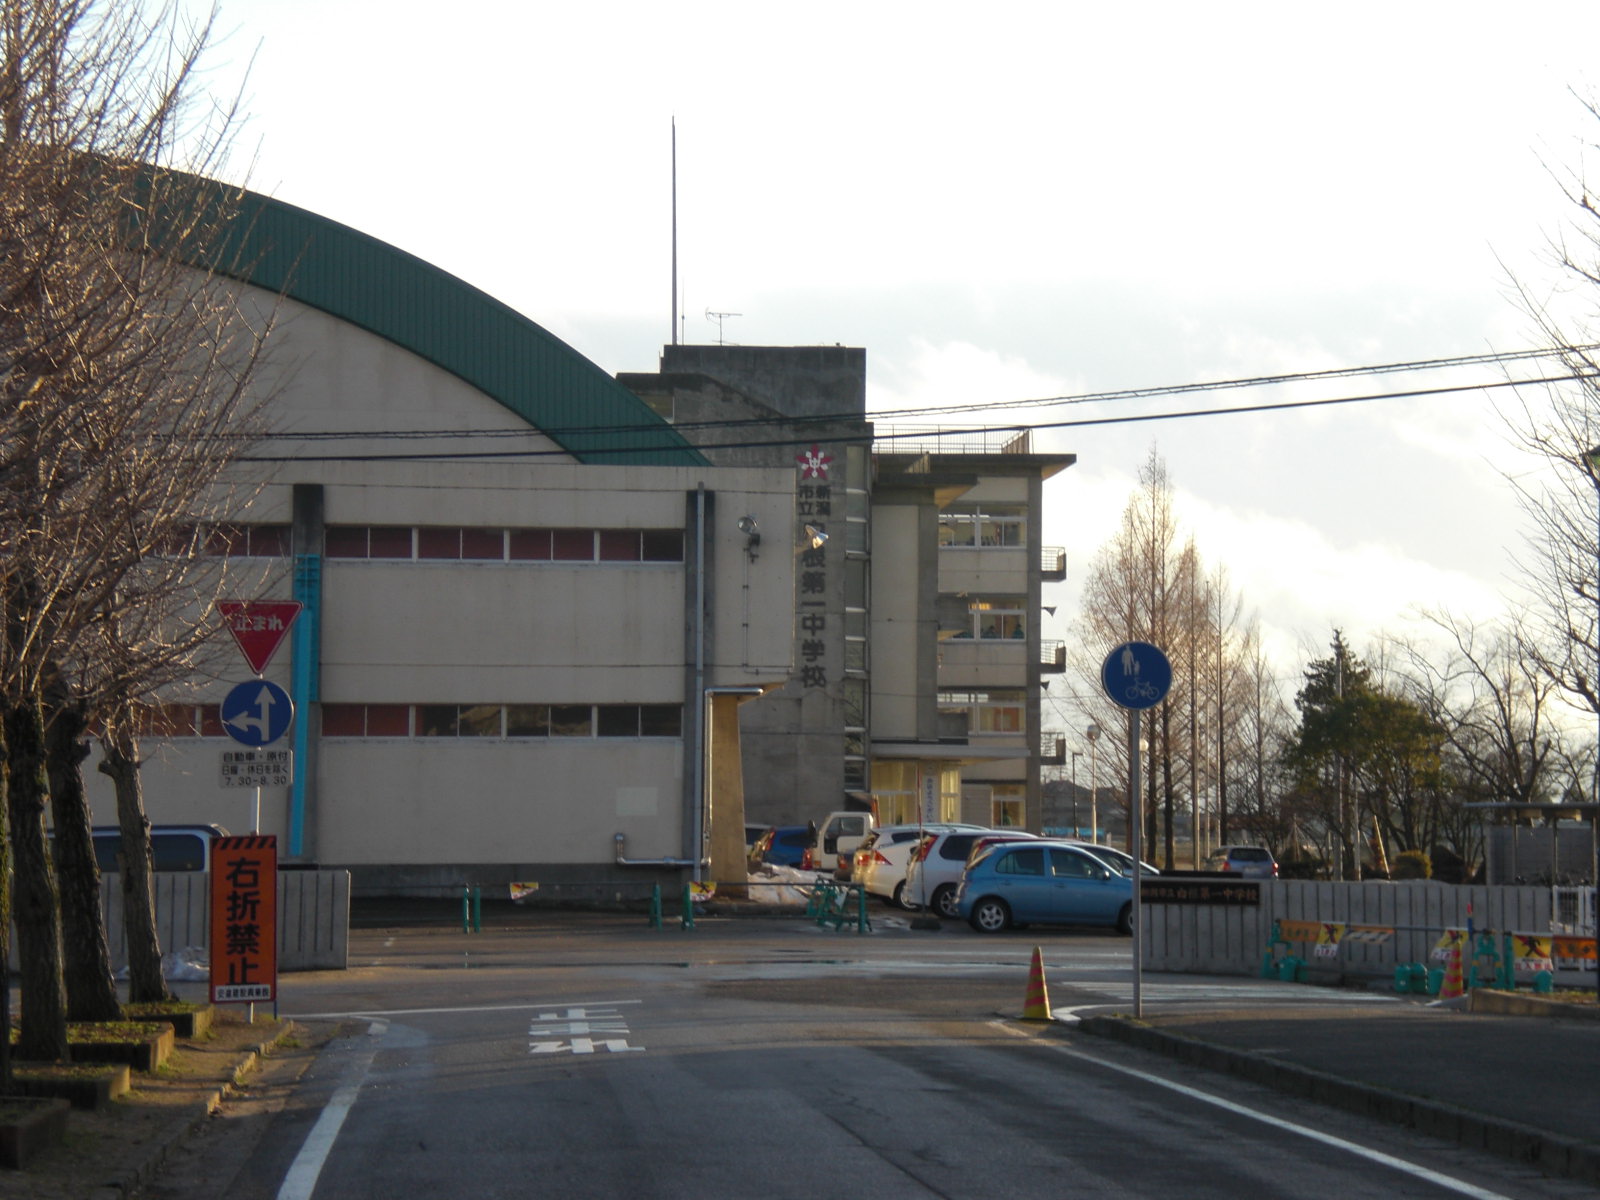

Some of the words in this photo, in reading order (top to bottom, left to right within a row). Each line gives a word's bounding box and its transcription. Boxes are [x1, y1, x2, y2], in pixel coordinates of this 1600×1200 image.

[798, 485, 814, 516] 市立
[234, 614, 285, 632] 止まれ
[225, 857, 261, 986] 右折禁止
